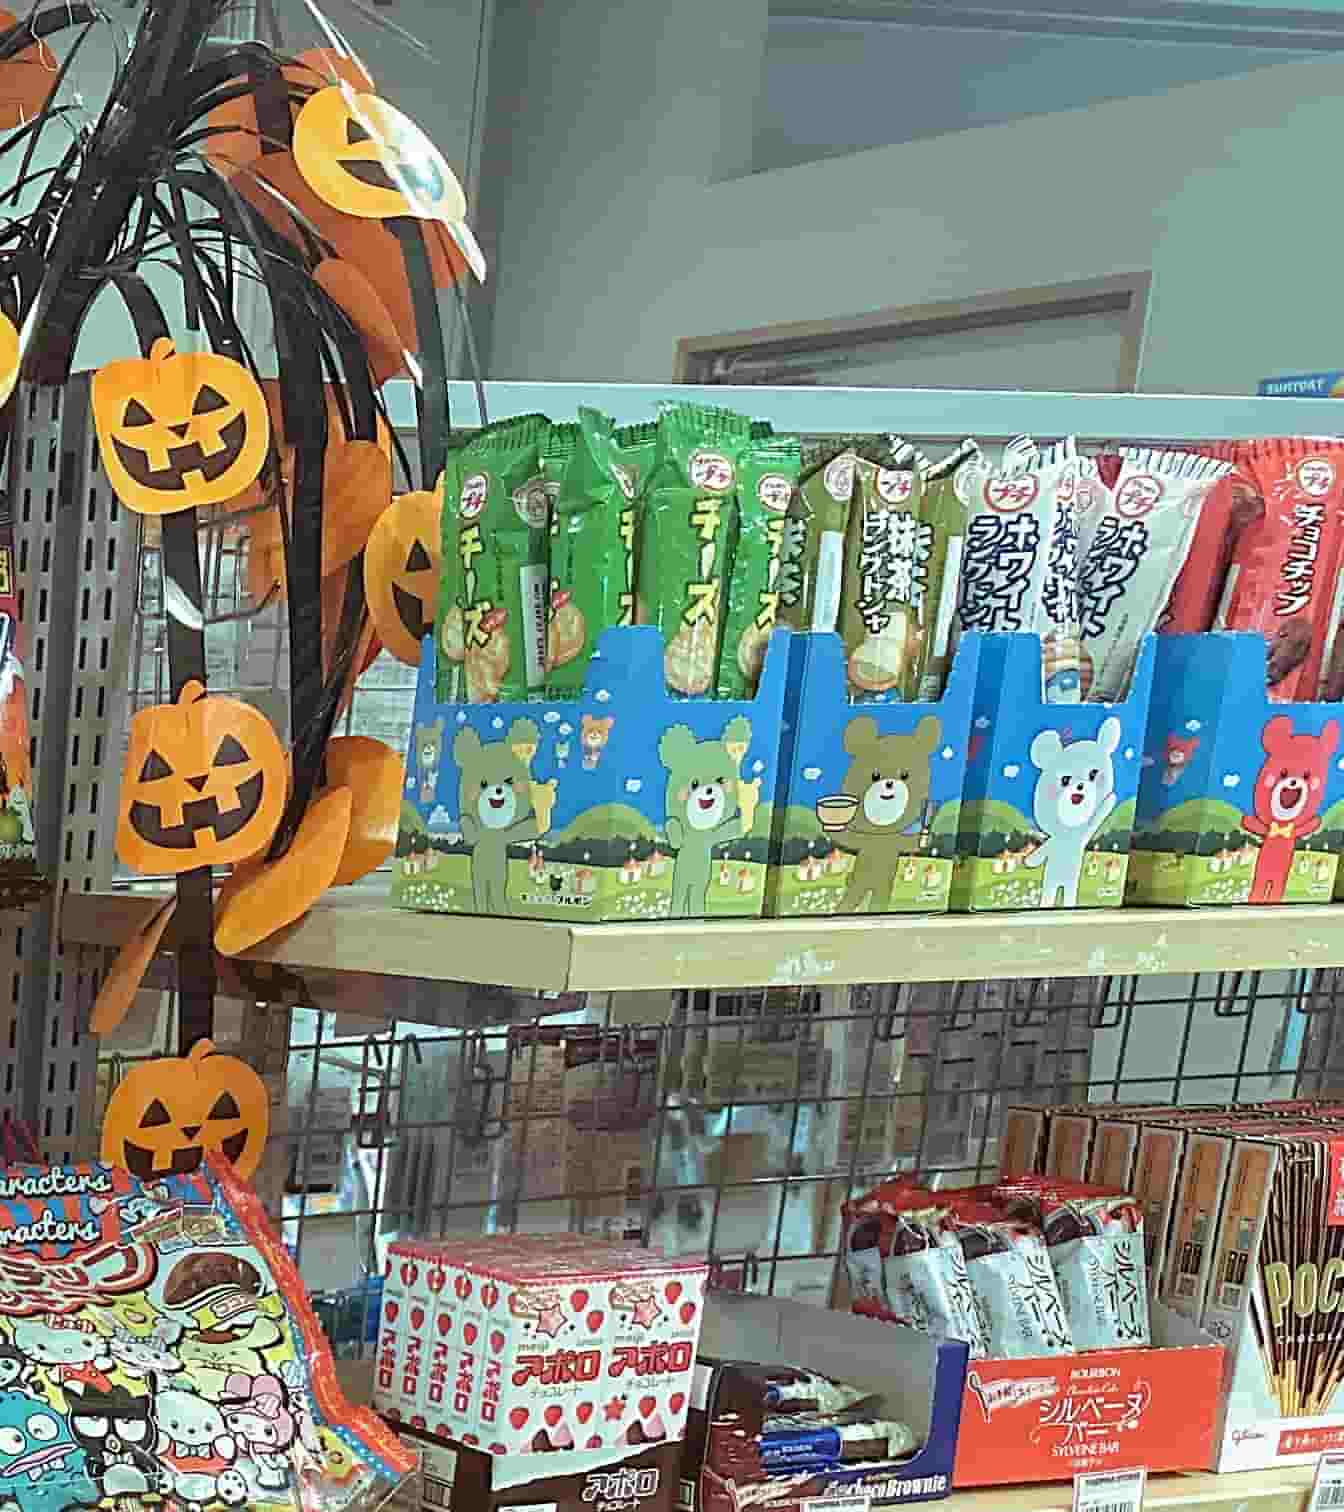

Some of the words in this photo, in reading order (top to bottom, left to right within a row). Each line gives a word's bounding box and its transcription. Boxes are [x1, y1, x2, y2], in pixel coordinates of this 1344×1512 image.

[683, 496, 724, 628] チーズ
[1264, 1258, 1344, 1328] POC
[511, 1349, 601, 1387] アポロ
[608, 1341, 693, 1377] アポロ
[1039, 1393, 1144, 1424] シルベーヌ
[582, 1466, 660, 1503] アポロ
